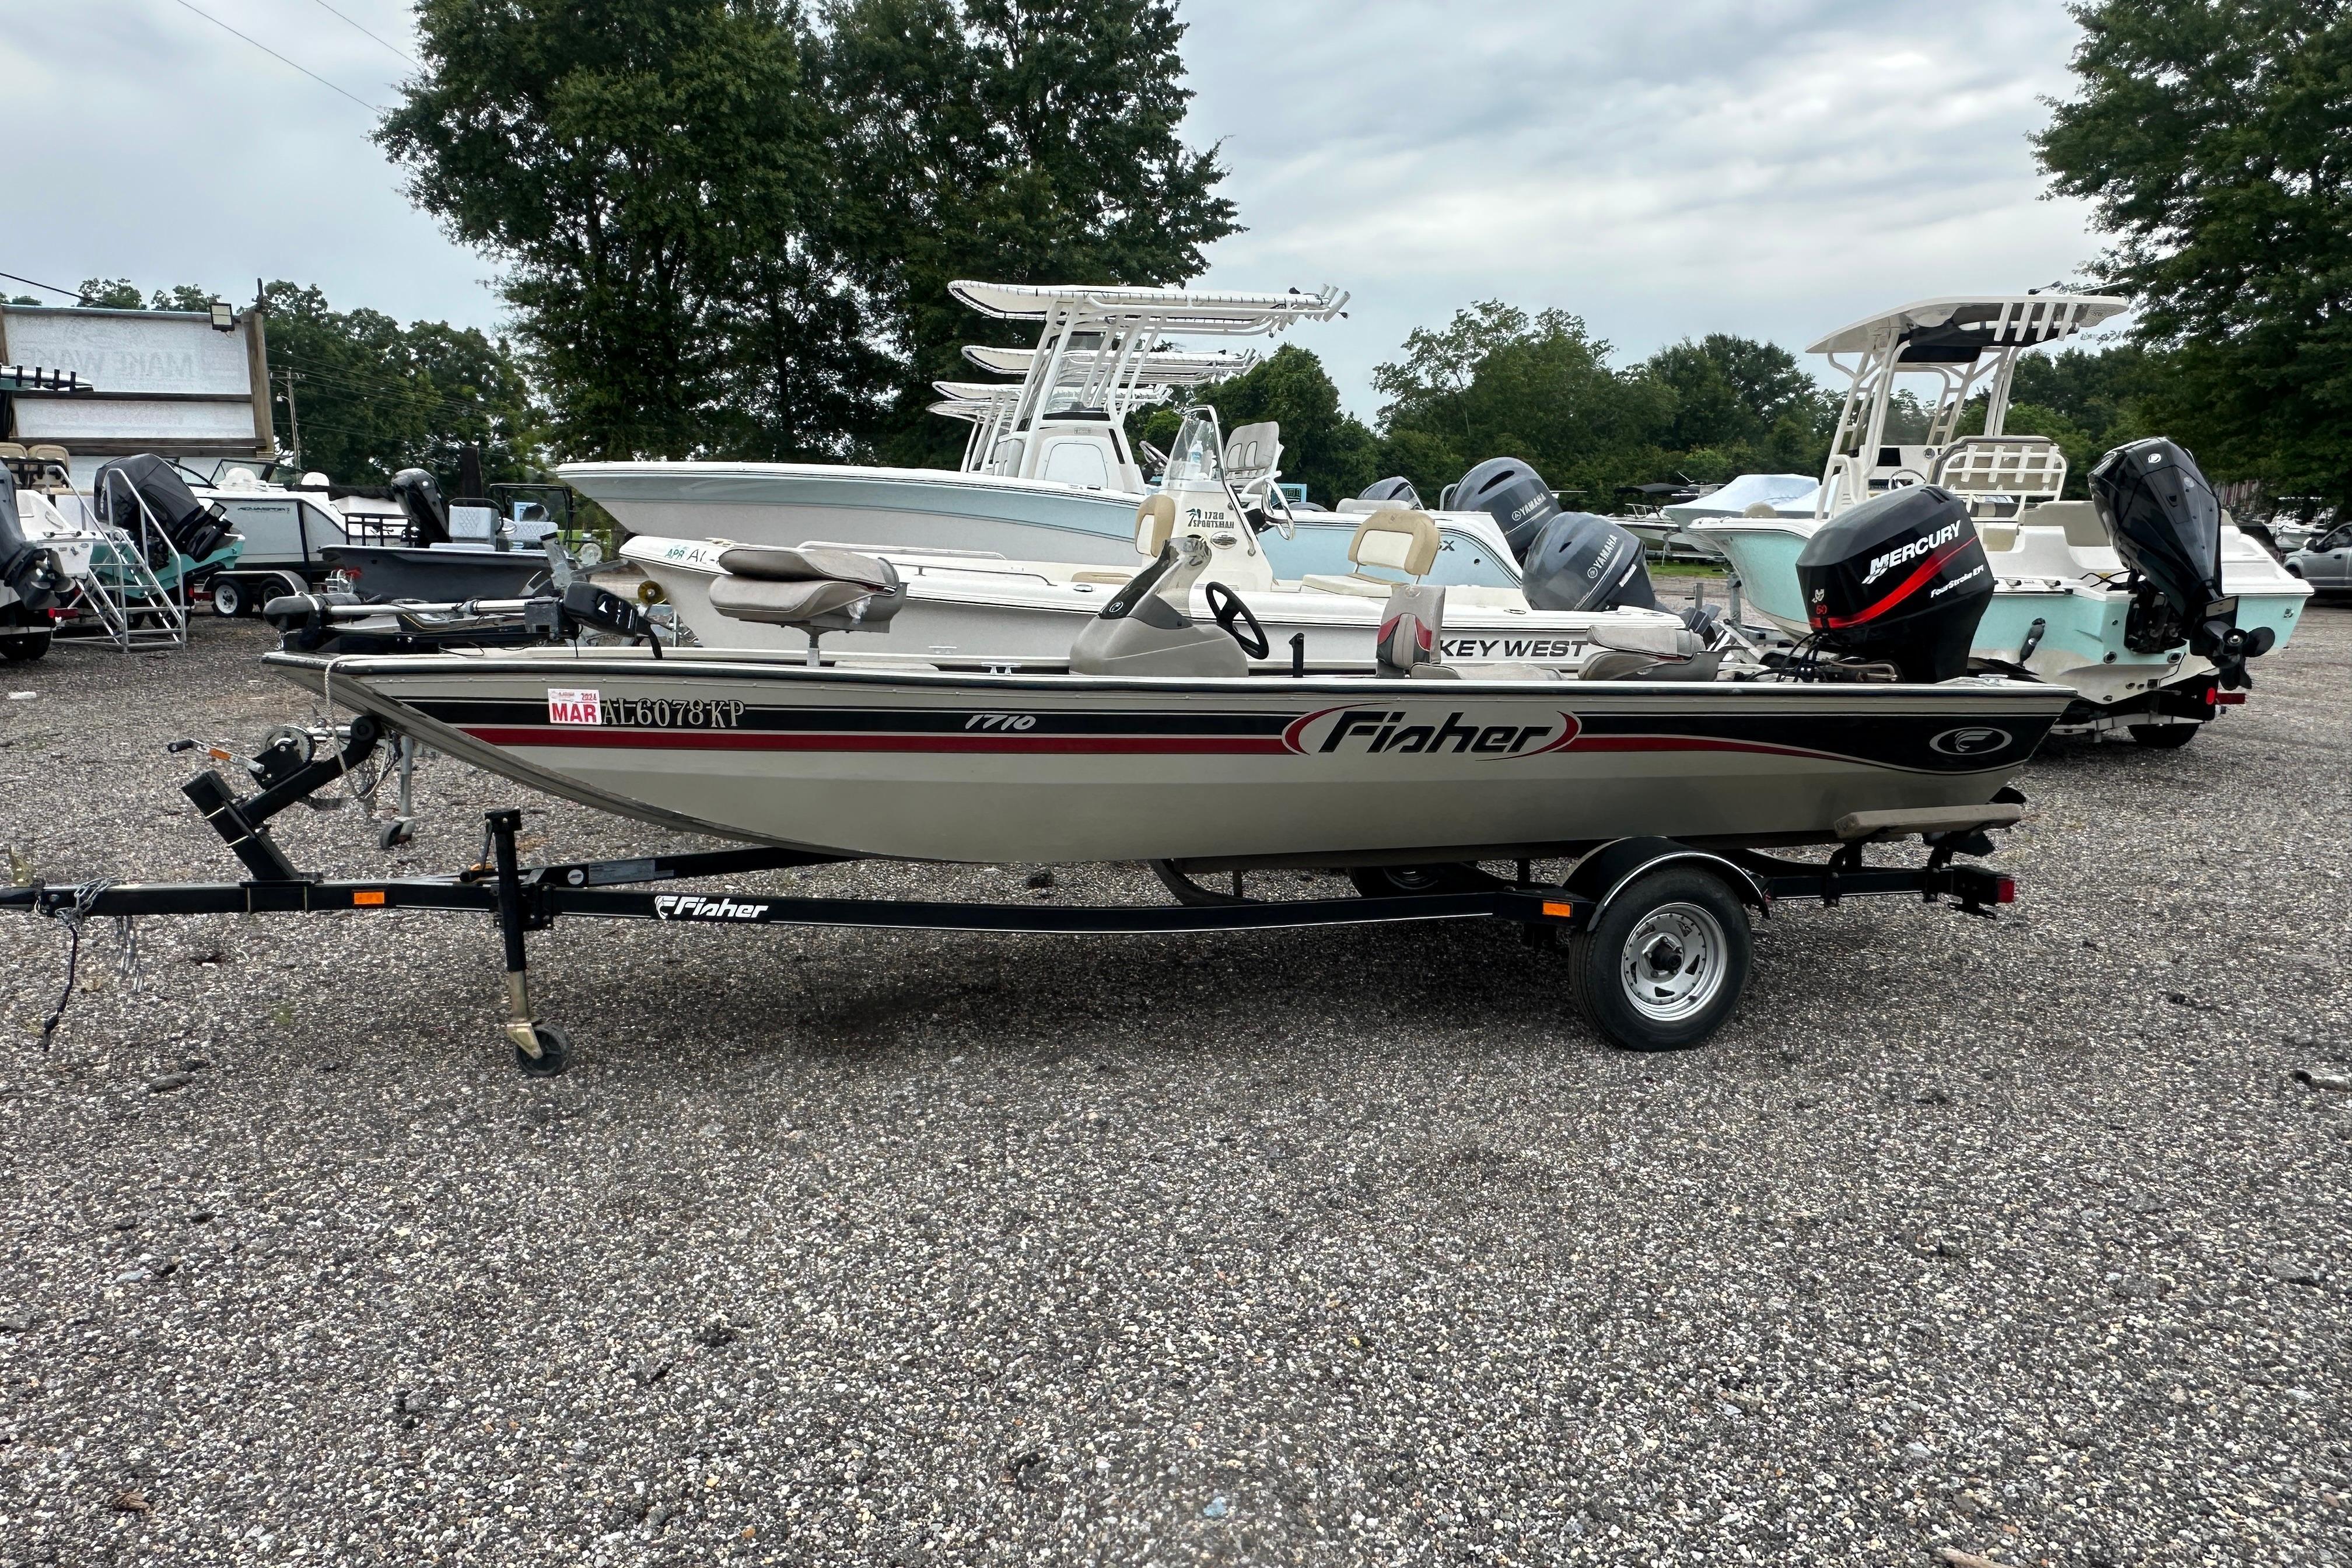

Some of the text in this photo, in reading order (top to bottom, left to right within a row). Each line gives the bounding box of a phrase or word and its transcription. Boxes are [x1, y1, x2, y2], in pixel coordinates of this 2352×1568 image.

[1520, 492, 1546, 516] YAMAHA
[664, 548, 685, 560] APR
[1593, 534, 1618, 569] YAMAHA
[1868, 520, 1961, 579] MERCURY
[1441, 640, 1588, 657] KEY WEST
[552, 703, 597, 723] MAR
[965, 714, 1037, 731] 1710
[1318, 711, 1553, 753] Fisher
[674, 896, 769, 919] Fisher
